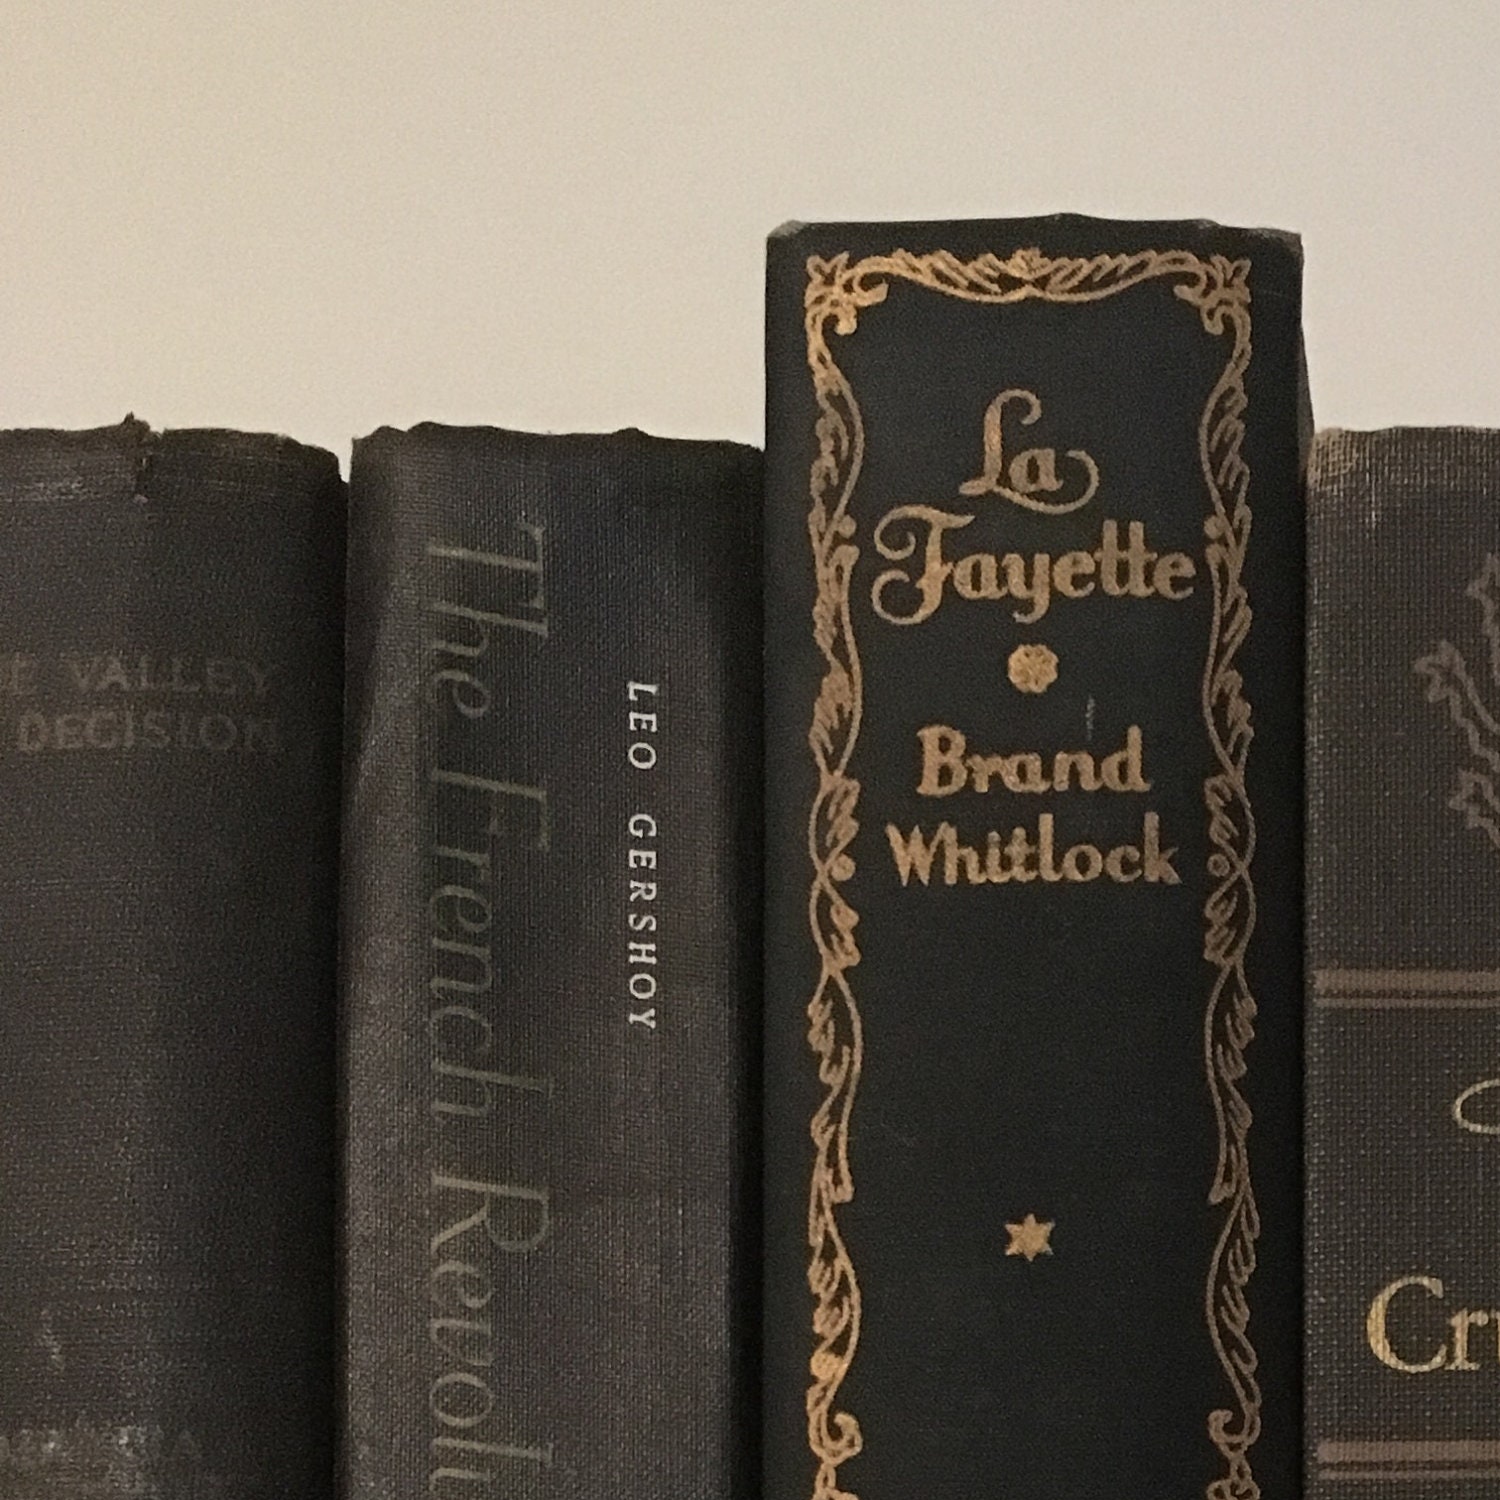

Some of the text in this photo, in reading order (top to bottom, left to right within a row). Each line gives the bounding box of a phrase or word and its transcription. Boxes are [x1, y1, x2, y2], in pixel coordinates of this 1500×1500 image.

[958, 388, 1100, 514] La
[428, 518, 549, 718] The
[871, 504, 1197, 625] Fayette
[17, 708, 283, 755] DECISION
[60, 653, 281, 695] VALLEY
[916, 724, 1152, 796] Brand
[625, 680, 660, 1031] LEO GERSHOY
[885, 812, 1183, 887] Whitlock
[428, 769, 555, 1121] French
